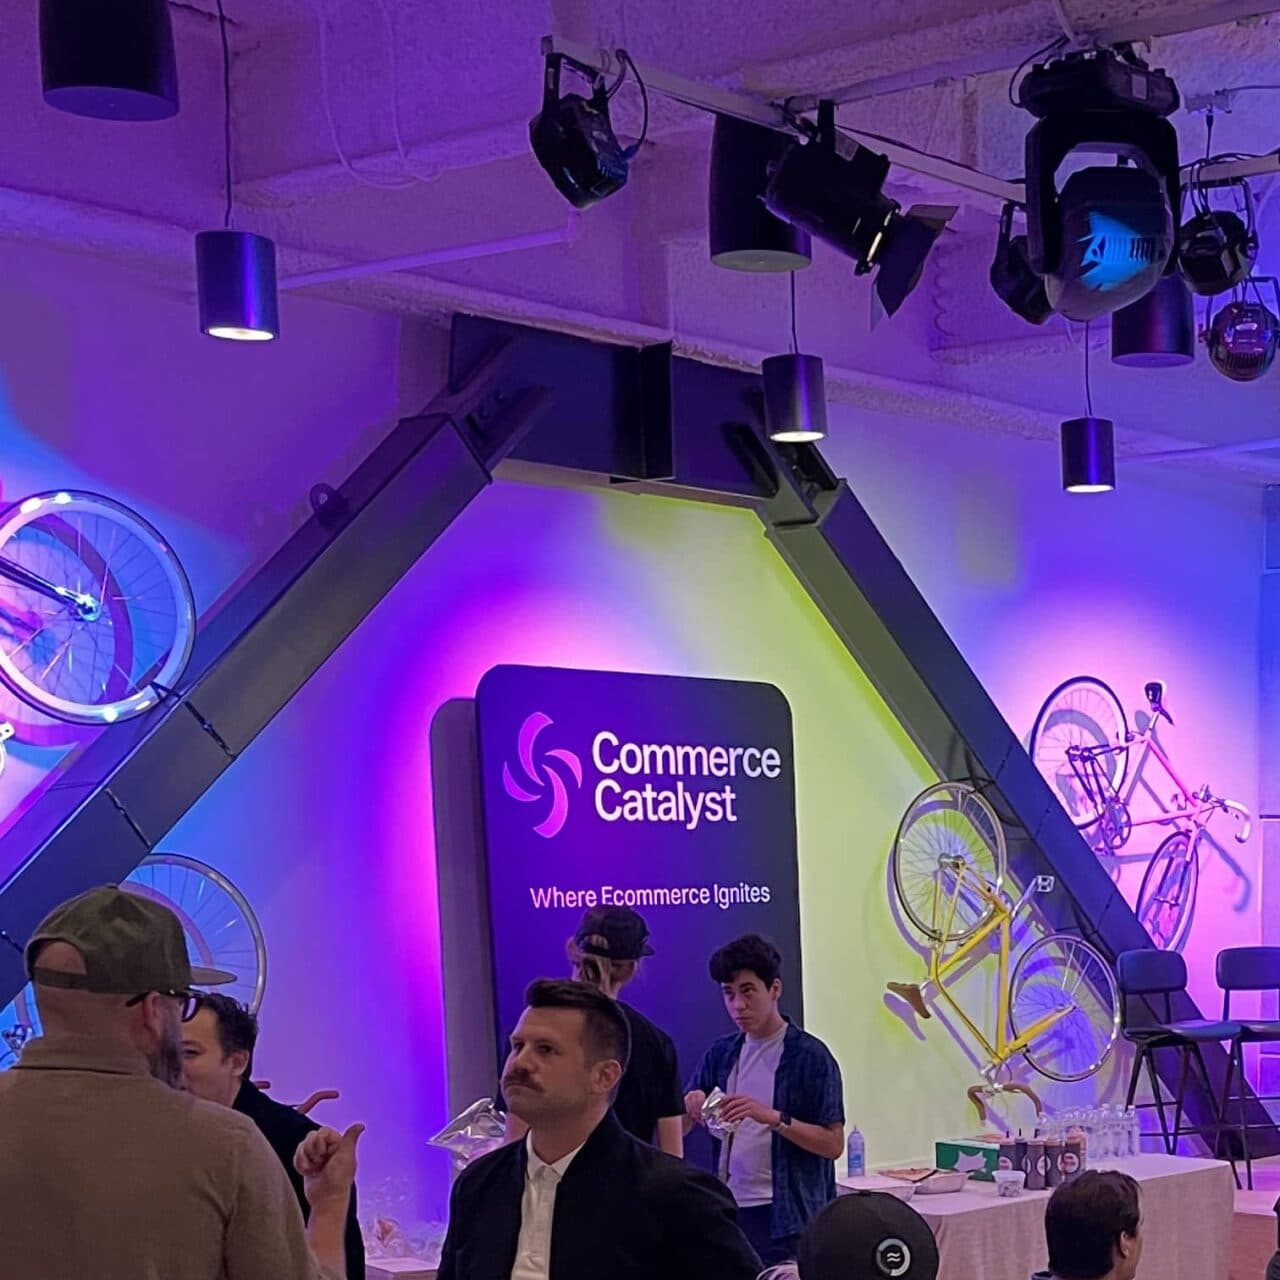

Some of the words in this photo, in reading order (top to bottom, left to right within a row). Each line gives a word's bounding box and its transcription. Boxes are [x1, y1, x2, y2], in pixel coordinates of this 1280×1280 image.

[592, 730, 782, 779] Commerce
[594, 778, 738, 830] Catalyst
[530, 886, 597, 908] Where
[601, 885, 710, 907] Ecommerce
[714, 882, 771, 909] Ignites
